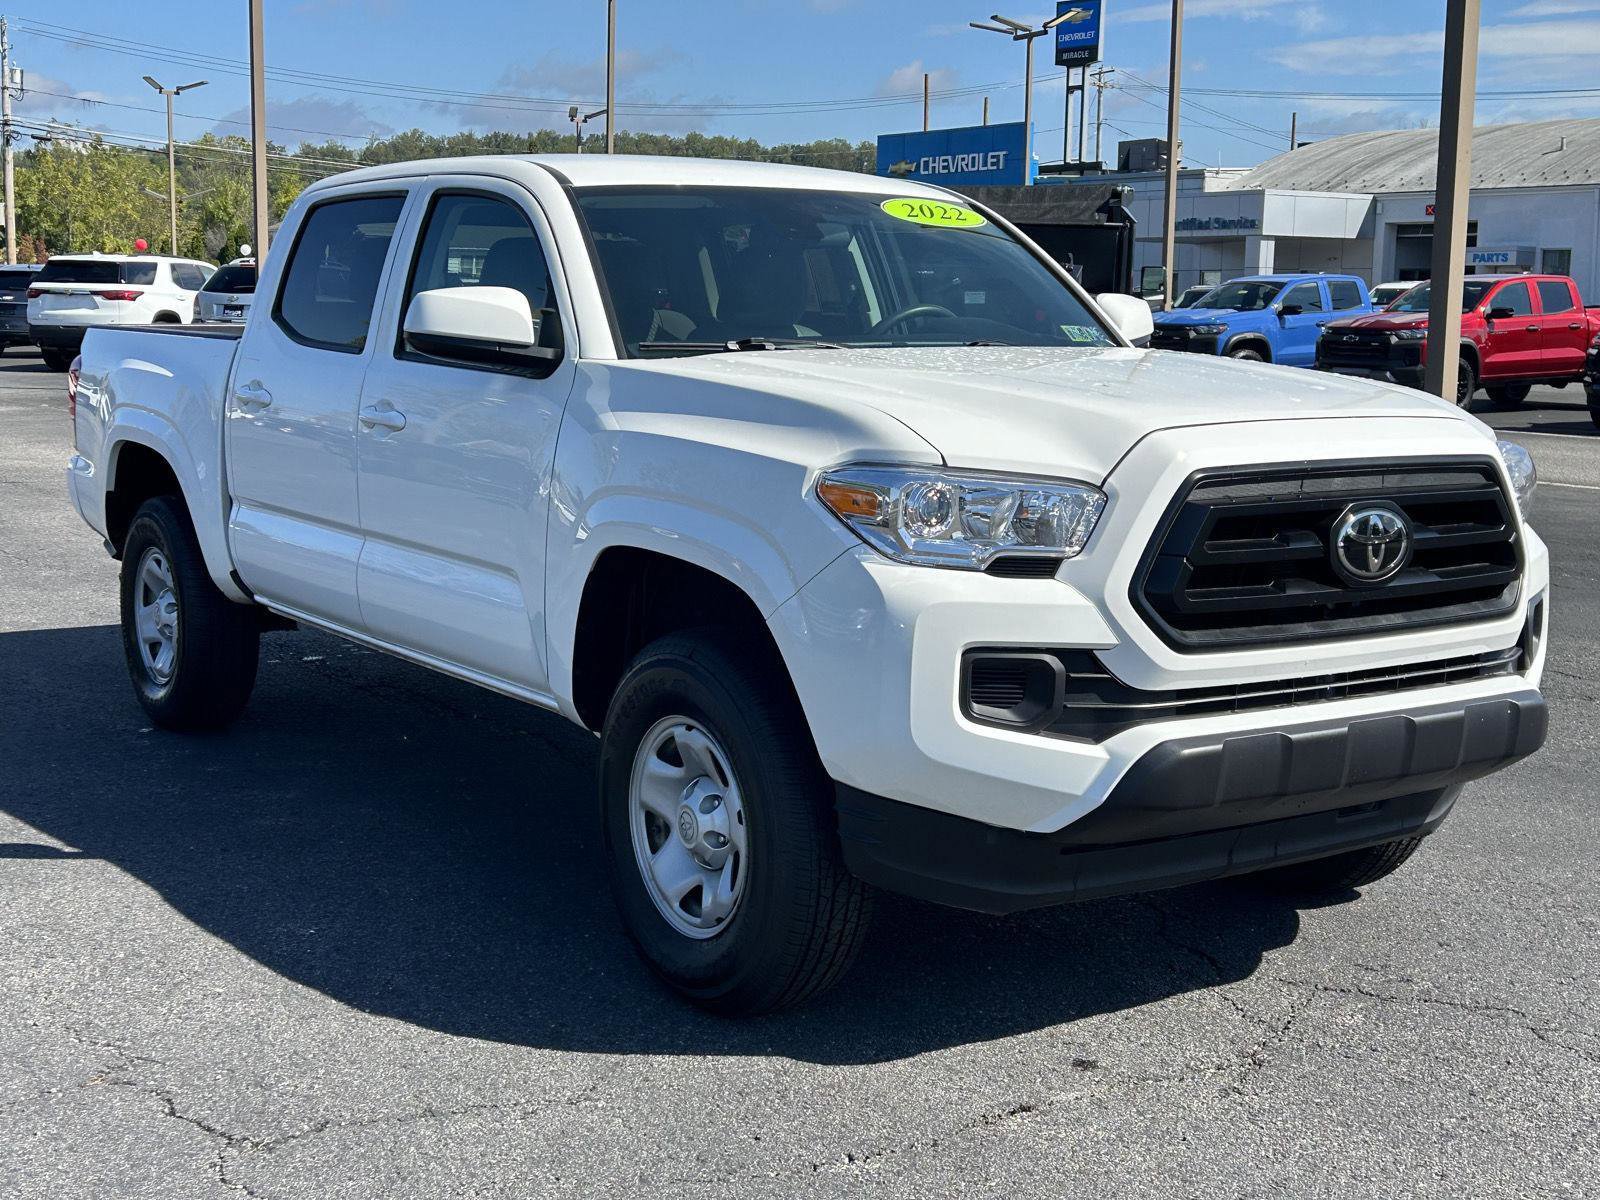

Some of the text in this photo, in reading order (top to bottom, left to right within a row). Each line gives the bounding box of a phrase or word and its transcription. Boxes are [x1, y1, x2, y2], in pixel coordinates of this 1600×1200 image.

[1058, 31, 1096, 42] CHEVROLET
[1062, 51, 1089, 60] MIRACLE
[920, 150, 1008, 175] CHEVROLET
[901, 203, 967, 221] 2022
[1472, 252, 1509, 263] PARTS
